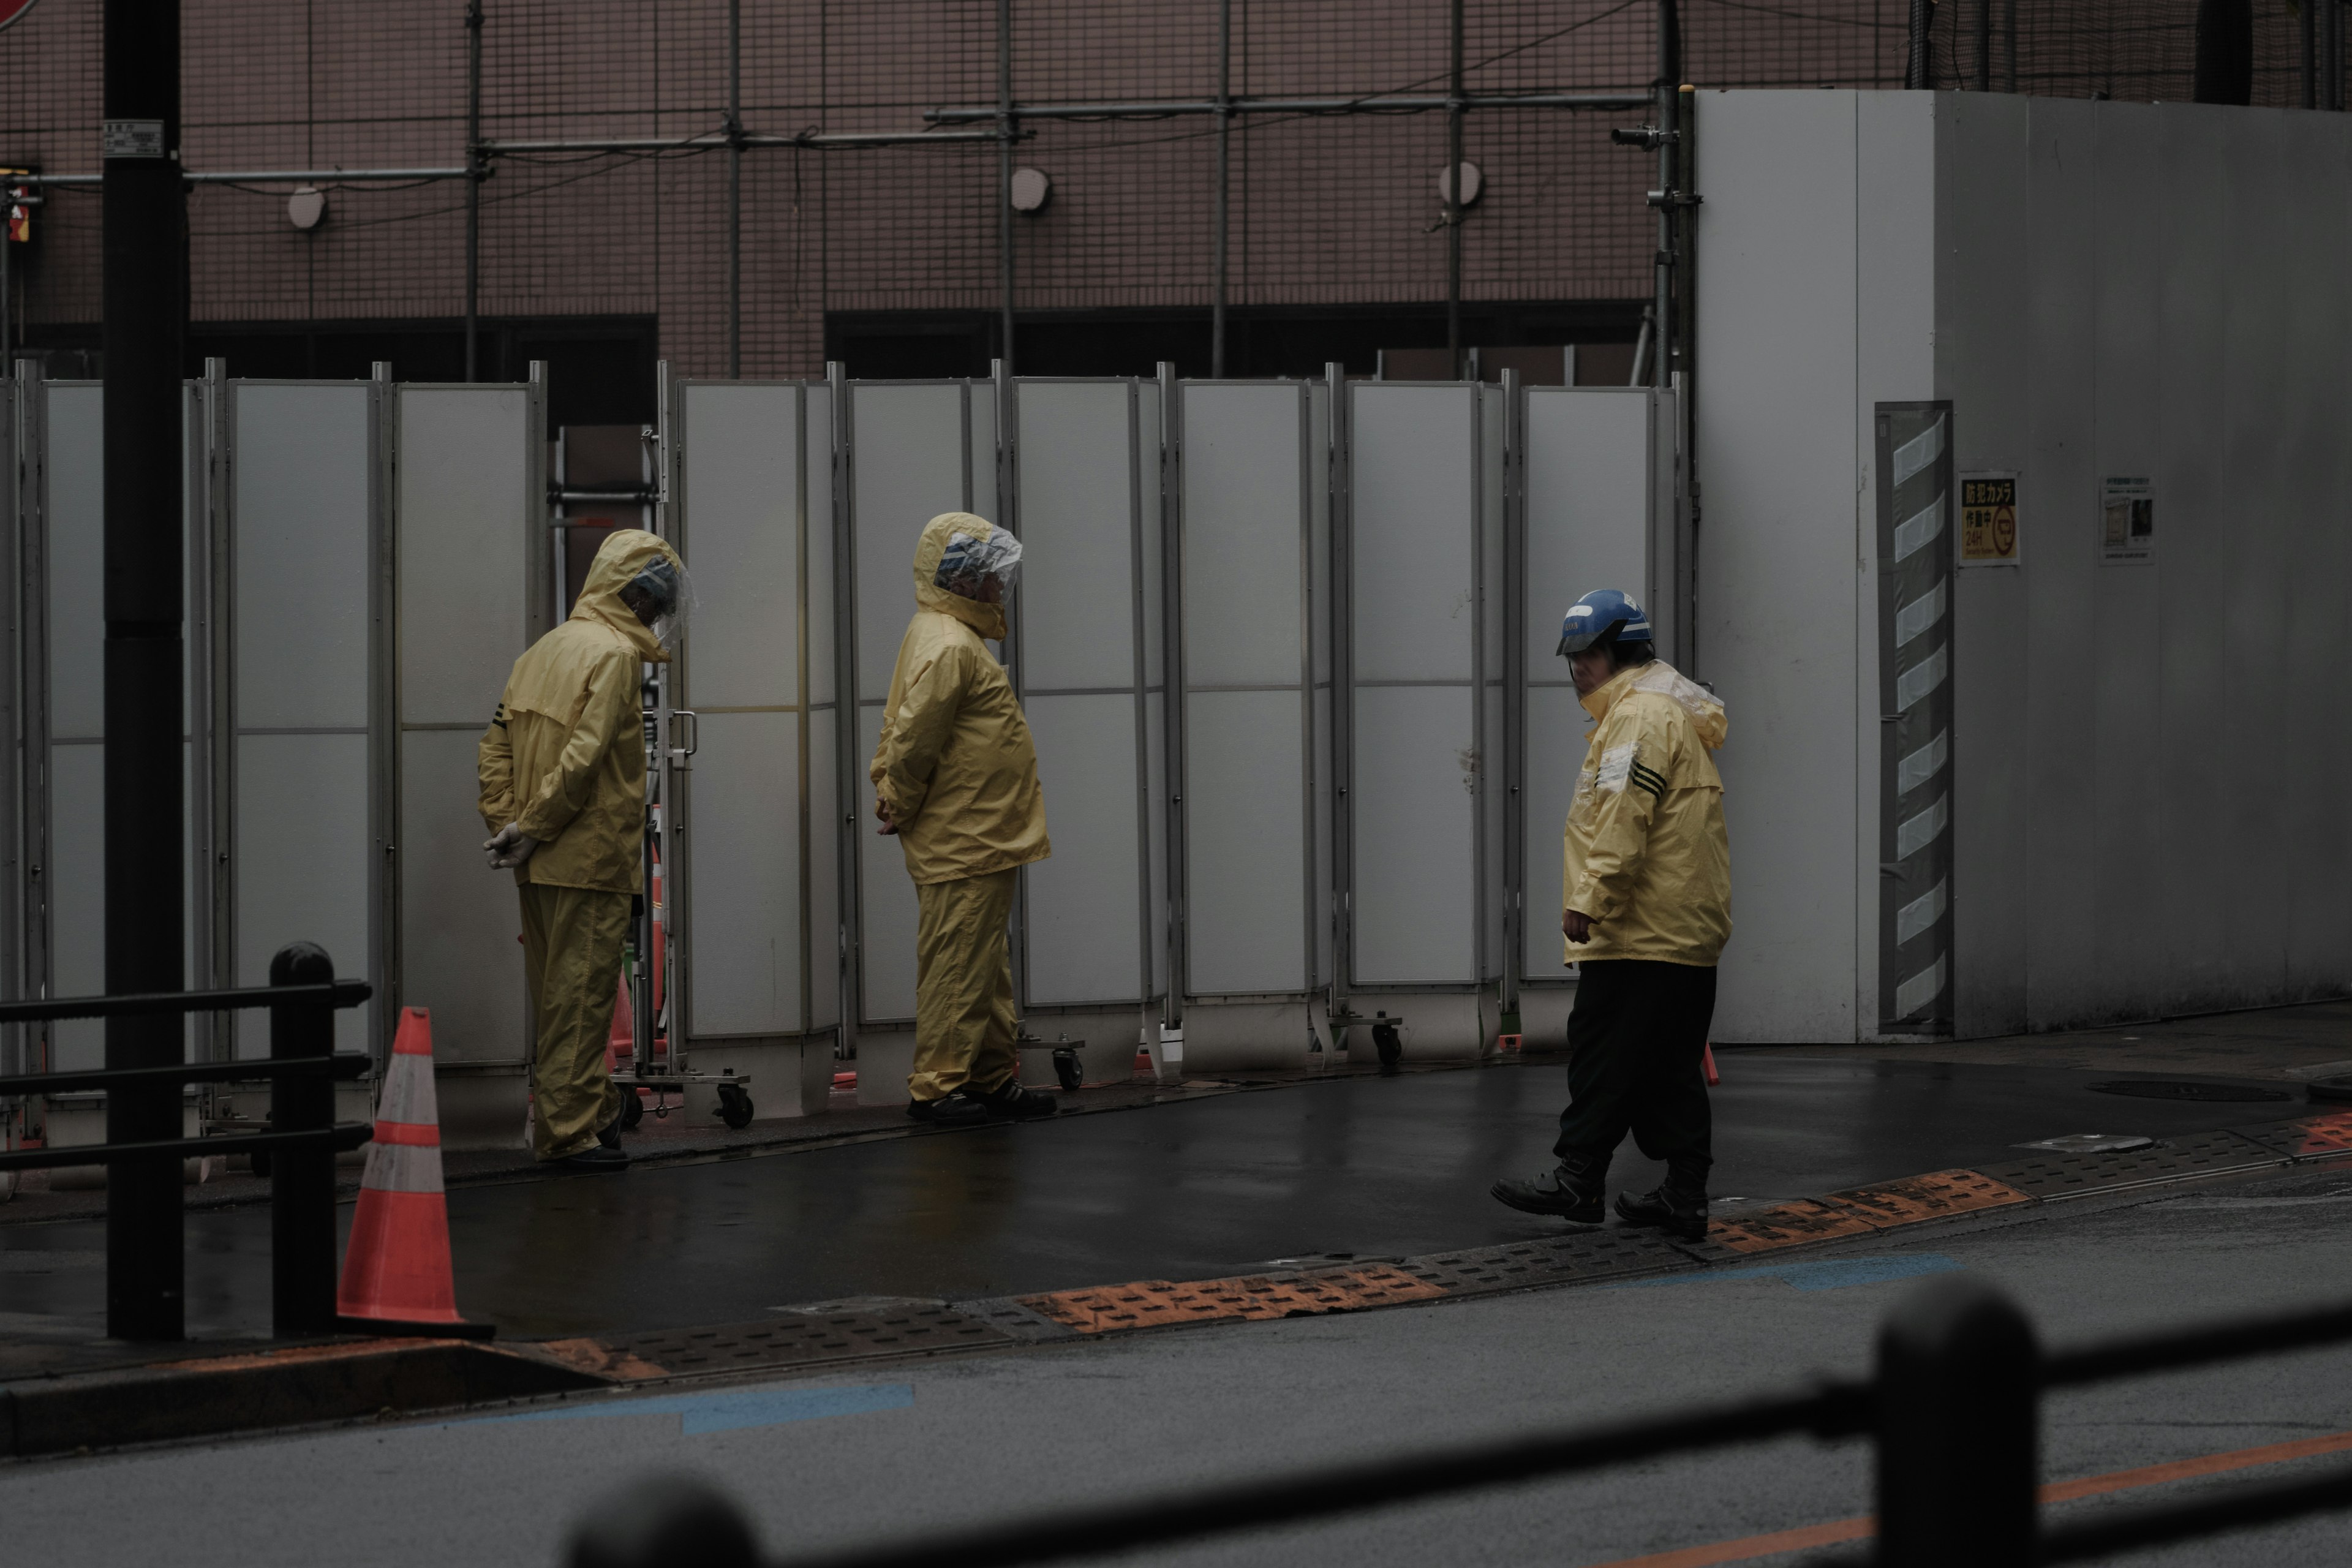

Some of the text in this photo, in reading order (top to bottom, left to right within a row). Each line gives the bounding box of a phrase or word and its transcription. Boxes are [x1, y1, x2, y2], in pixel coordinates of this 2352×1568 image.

[1966, 483, 2011, 504] 防犯カメラ
[1966, 510, 1991, 528] 作動中
[1966, 530, 1982, 546] 24H
